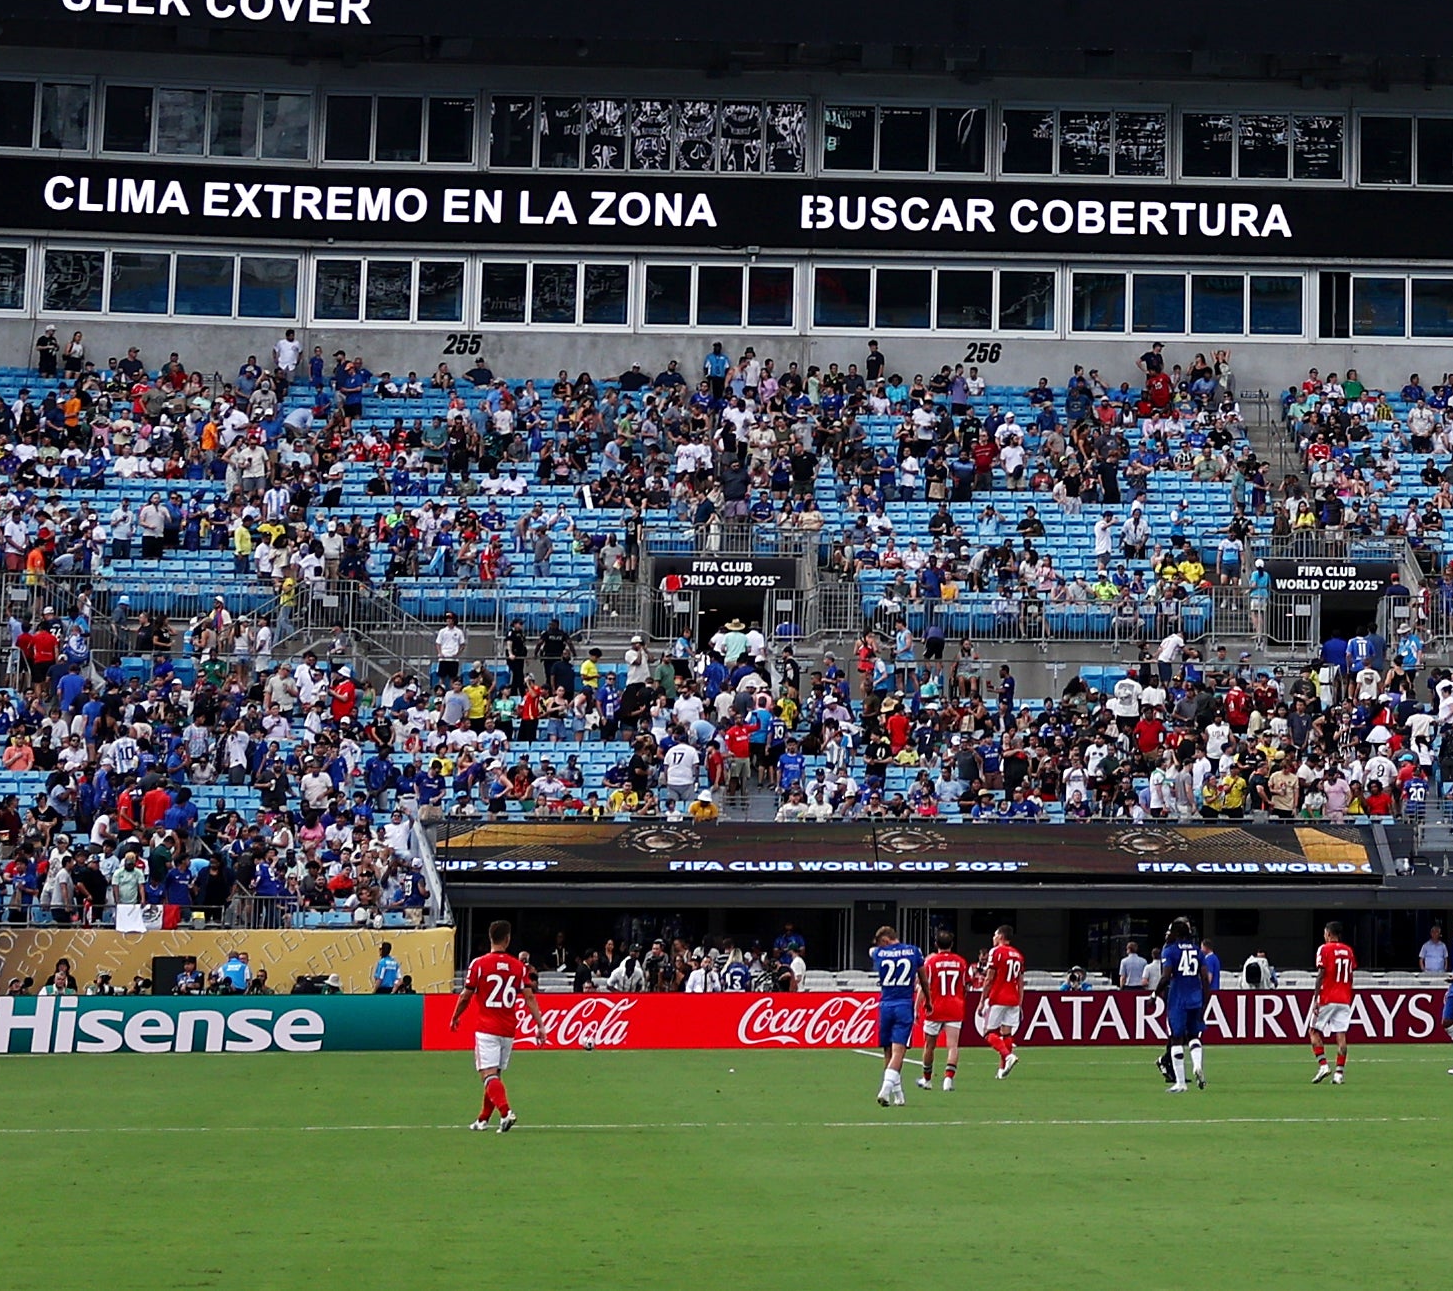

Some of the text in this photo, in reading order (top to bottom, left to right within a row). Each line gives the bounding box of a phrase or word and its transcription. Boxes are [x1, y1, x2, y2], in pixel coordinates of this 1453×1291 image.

[45, 176, 717, 226] CLIMA EXTREMO EN LA ZONA
[801, 195, 1292, 237] BUSCAR COBERTURA
[443, 331, 482, 355] 255
[962, 342, 1001, 364] 256
[1275, 578, 1319, 591] WORLD
[1322, 579, 1346, 591] CUP
[1298, 566, 1356, 578] FIFA CLUB
[673, 753, 685, 764] 17
[669, 861, 724, 872] FIFA
[728, 861, 794, 872] CLUB
[796, 861, 893, 872] WORLD
[908, 861, 950, 872] CUP
[881, 957, 911, 986] 22
[1178, 950, 1199, 977] 45
[1335, 958, 1351, 983] 11
[486, 974, 516, 1009] 26
[938, 969, 958, 996] 17
[514, 996, 638, 1047] oca-Cola
[738, 996, 881, 1046] Coca-Cola
